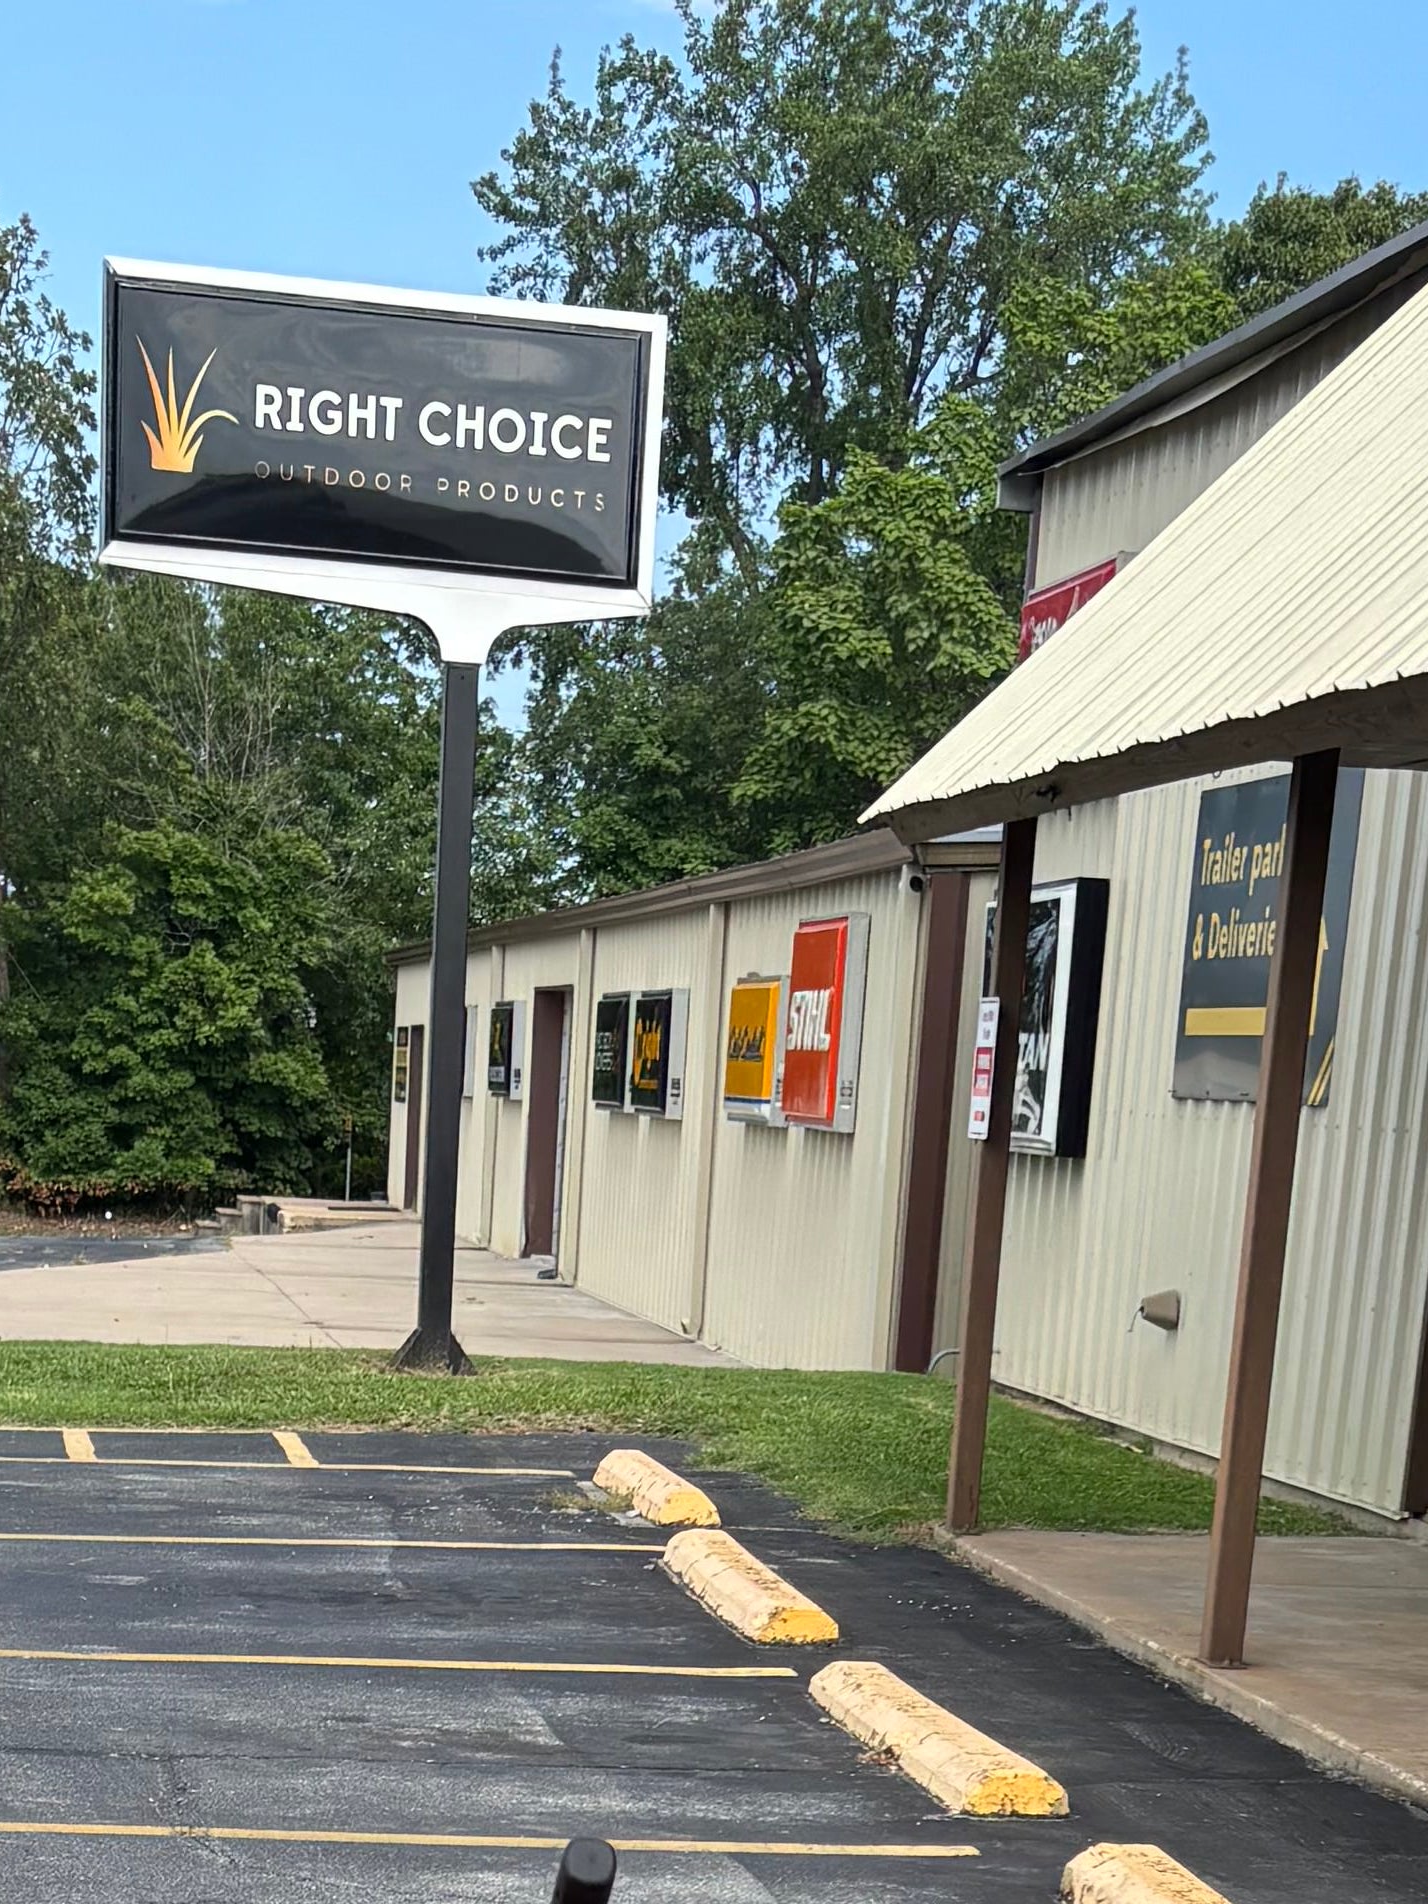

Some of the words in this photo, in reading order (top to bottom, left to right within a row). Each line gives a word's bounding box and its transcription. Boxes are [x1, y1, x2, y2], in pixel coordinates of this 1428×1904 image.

[253, 383, 404, 441] RIGHT
[417, 400, 614, 463] CHOICE
[253, 460, 414, 494] OUTDOOR
[436, 477, 607, 512] PRODUCTS
[1201, 832, 1247, 886] Trailer
[1192, 913, 1204, 961] &
[1206, 905, 1277, 960] Deliverie
[787, 989, 834, 1052] STIHL
[1018, 1032, 1049, 1071] TAN
